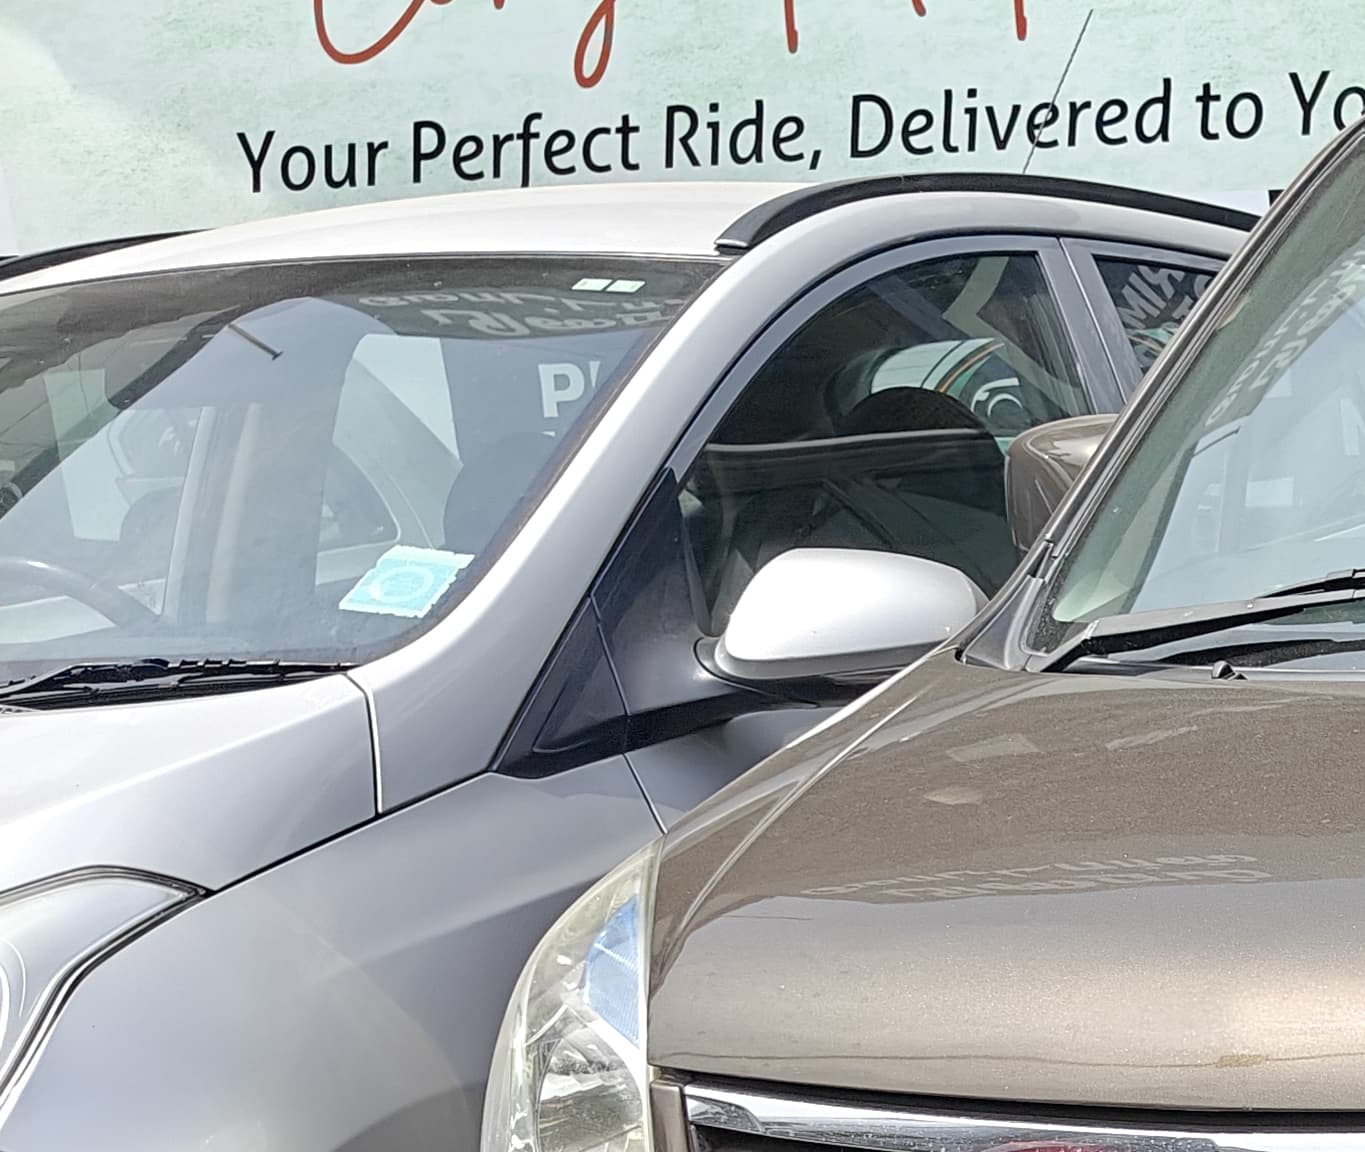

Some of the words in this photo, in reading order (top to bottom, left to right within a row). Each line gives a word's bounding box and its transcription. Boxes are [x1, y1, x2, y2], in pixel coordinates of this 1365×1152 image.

[236, 130, 389, 194] Your
[412, 112, 641, 188] Perfect
[665, 99, 822, 171] Ride,
[850, 77, 1172, 158] Delivered
[1196, 82, 1264, 140] to
